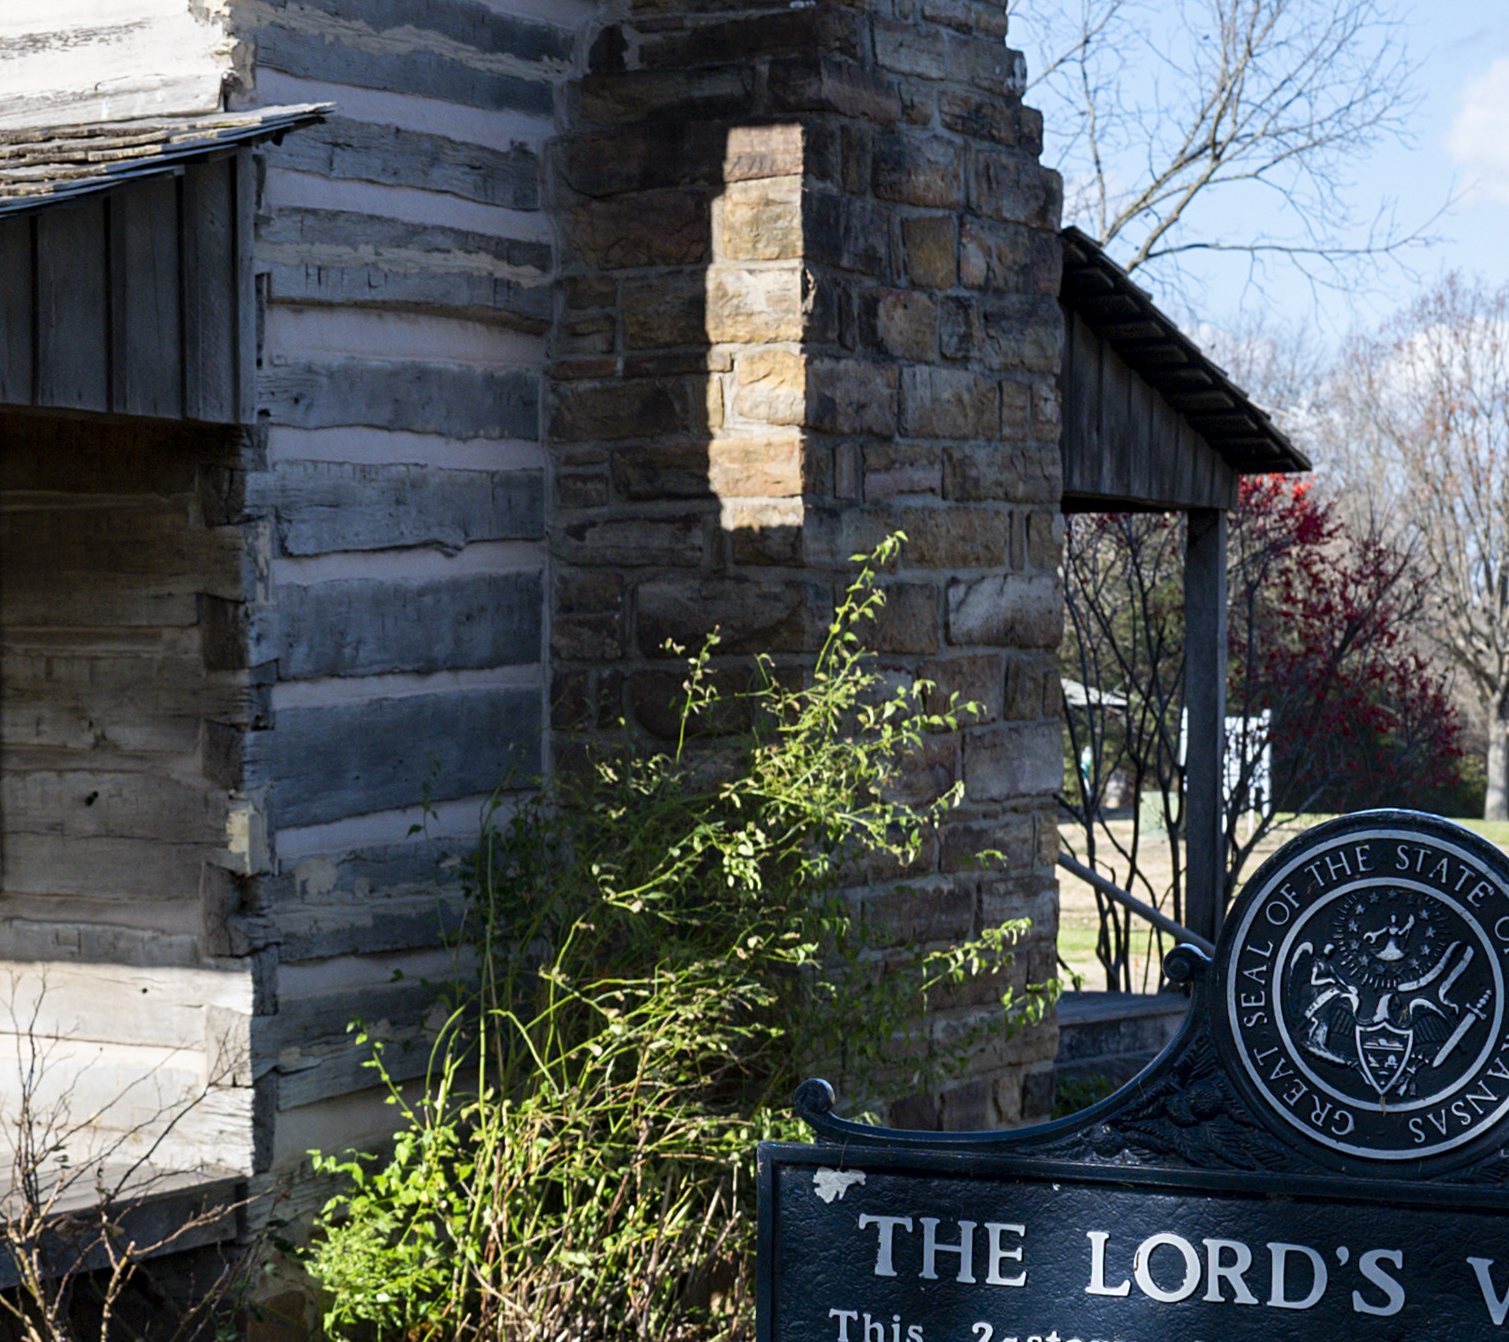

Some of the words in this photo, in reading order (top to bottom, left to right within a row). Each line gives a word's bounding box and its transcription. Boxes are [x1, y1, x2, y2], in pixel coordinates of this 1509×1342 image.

[1265, 882, 1305, 926] OF
[1304, 844, 1375, 888] THE
[1395, 844, 1495, 910] STATE
[1240, 939, 1274, 1029] SEAL
[1253, 1046, 1356, 1137] GREAT
[858, 1212, 1027, 1287] THE
[1083, 1230, 1406, 1316] LORD'S
